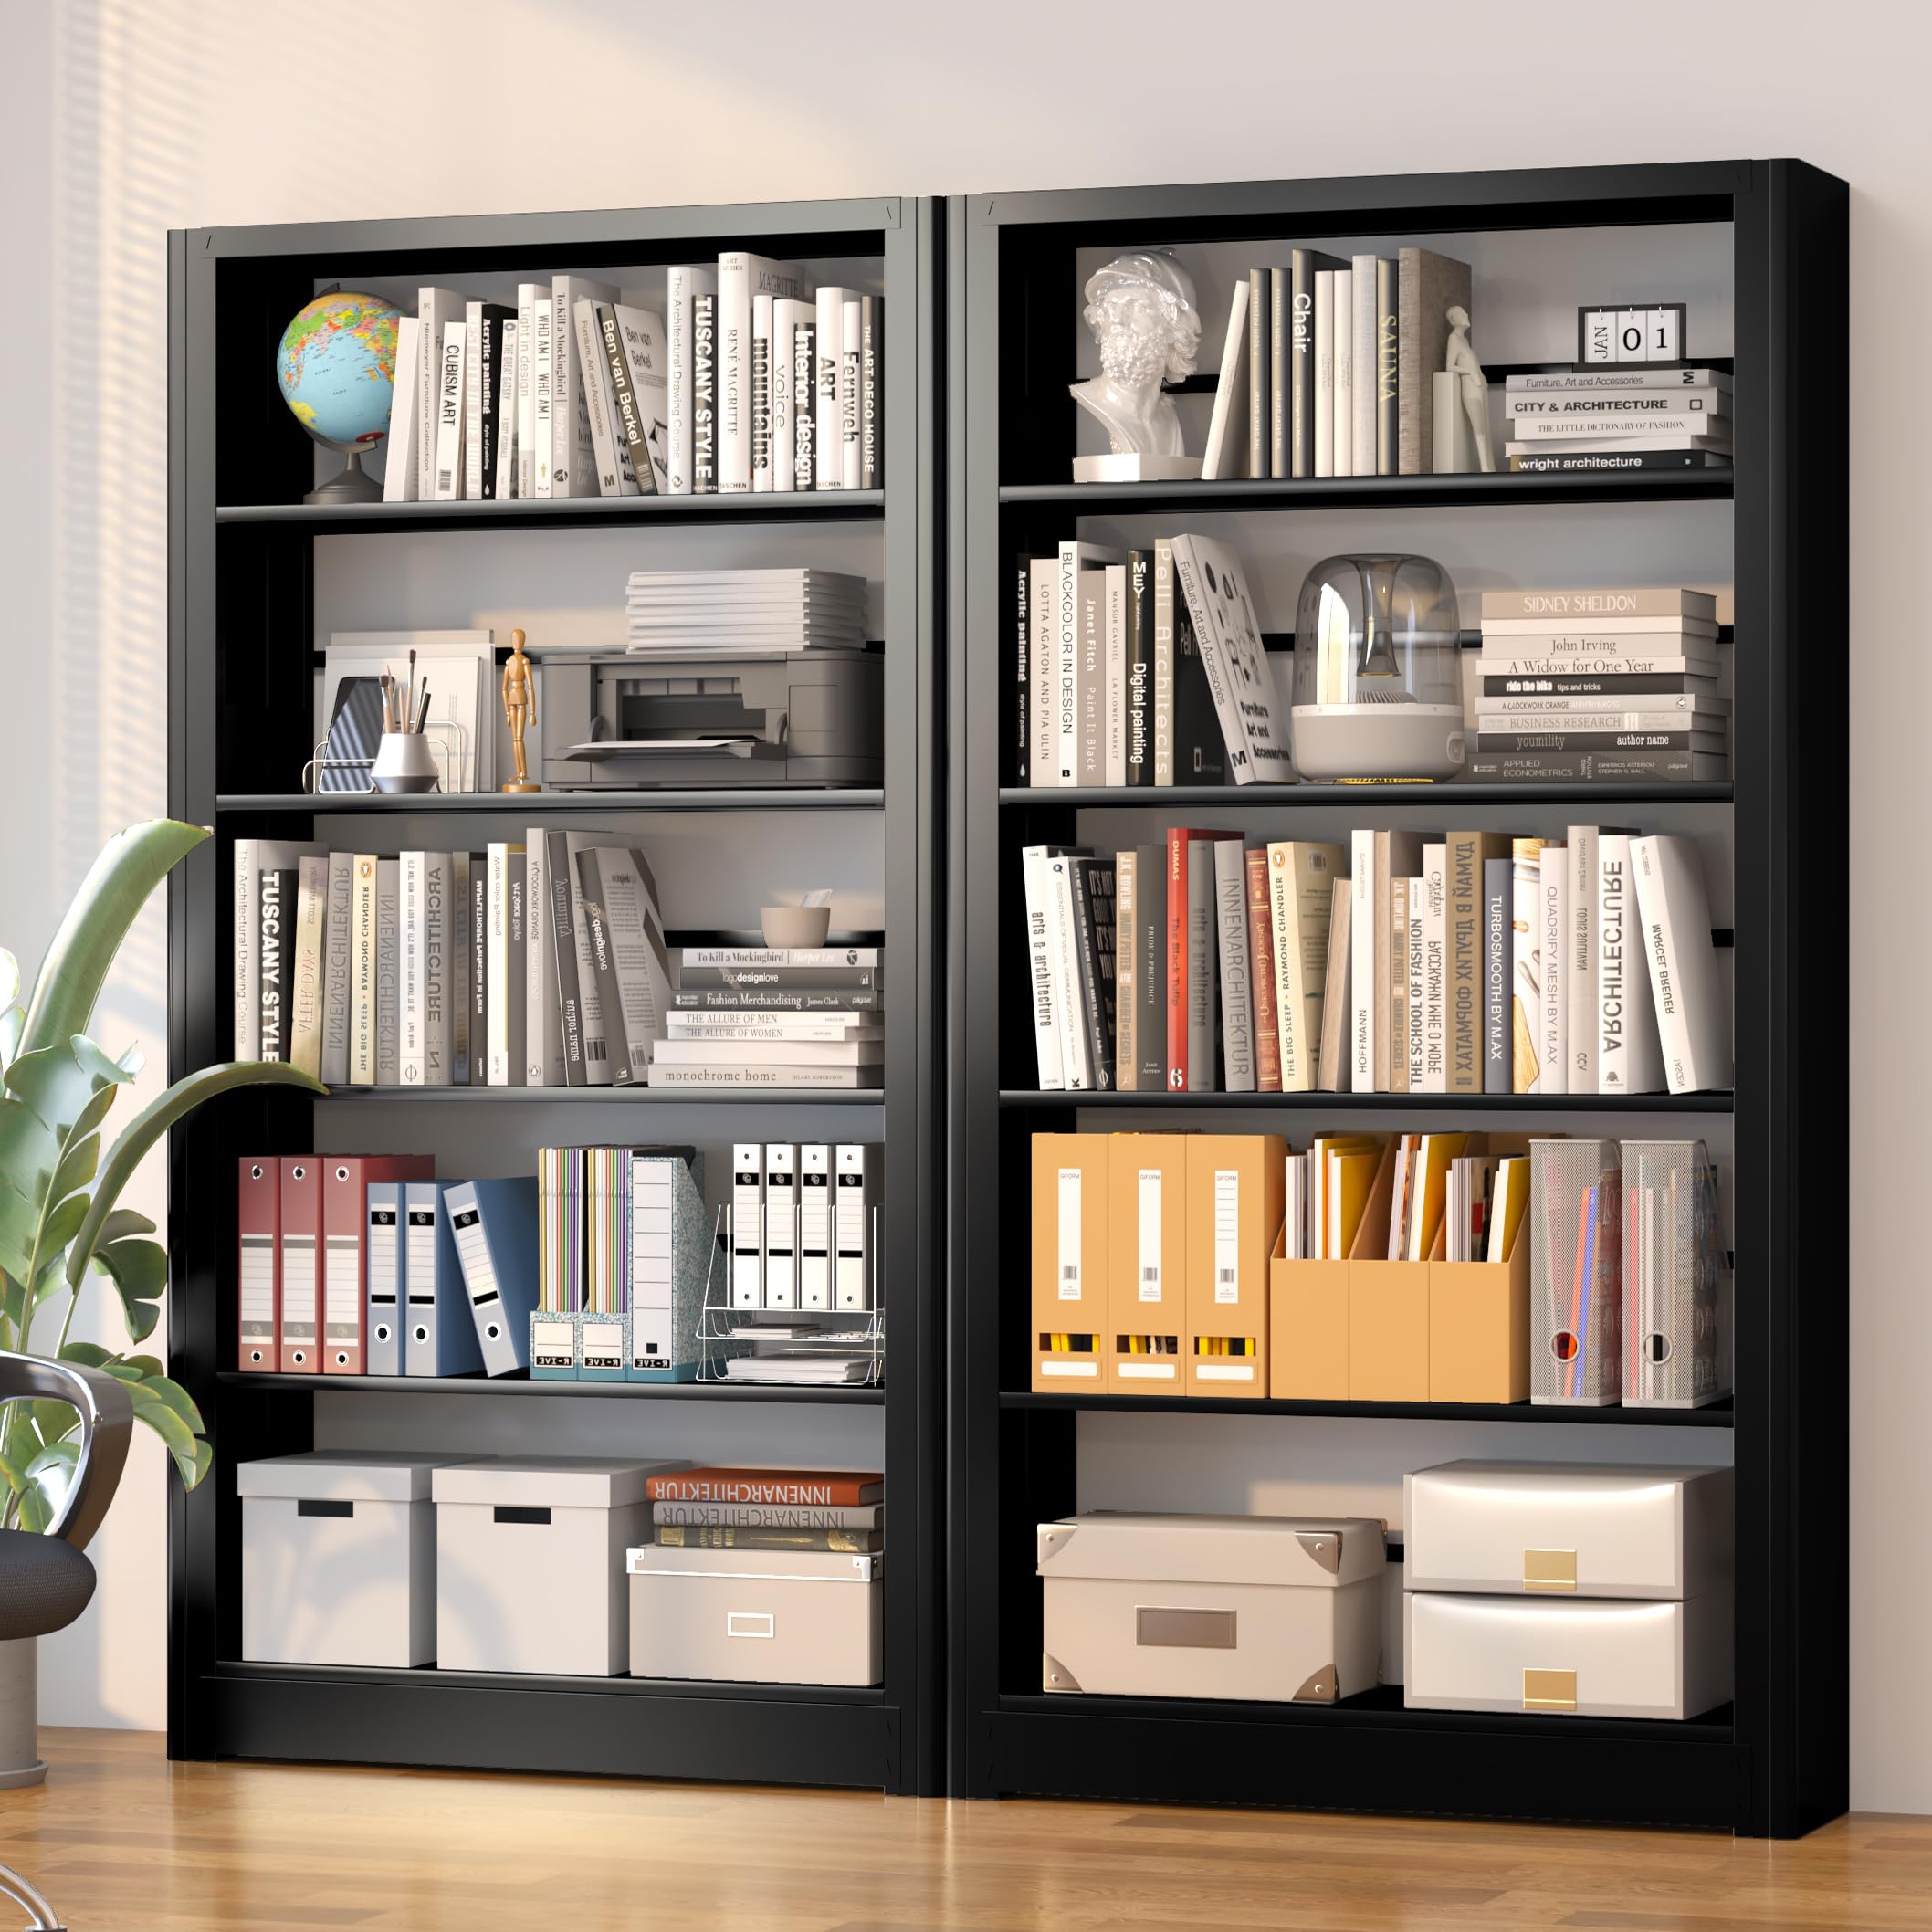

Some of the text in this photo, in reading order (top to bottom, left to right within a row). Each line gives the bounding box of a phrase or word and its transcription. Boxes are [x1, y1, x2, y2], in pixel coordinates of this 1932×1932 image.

[759, 271, 799, 298] MAGRITTE
[482, 319, 491, 360] Acrylic
[1293, 293, 1312, 353] Chair
[1594, 326, 1608, 359] JAN
[671, 276, 683, 459] The Architectural Drawing Course
[820, 357, 835, 401] ART
[864, 349, 875, 376] ART
[1380, 314, 1397, 403] SAUNA
[1682, 371, 1694, 384] M
[442, 345, 460, 426] CUBISM ART
[482, 362, 491, 415] painting
[602, 320, 642, 446] Ben van Berkel
[695, 297, 713, 478] TUSCANY STYLE
[727, 329, 740, 436] RENÉ MAGRITTE
[775, 365, 789, 428] voice
[843, 351, 860, 443] Fernweh
[864, 382, 875, 419] DECO
[1526, 376, 1643, 388] Furniture, Art and Accessories
[753, 337, 770, 470] mountains
[795, 330, 816, 486] Interior design
[1514, 399, 1668, 413] CITY & ARCHITECTURE
[1538, 420, 1685, 433] THE LITTLE DICTIONARY OF FASHION
[864, 425, 875, 473] HOUSE
[1518, 457, 1643, 471] wright architecture
[1132, 562, 1147, 600] MEY
[1523, 594, 1637, 613] SIDNEY SHELDON
[1062, 552, 1073, 734] BLACKCOLOR IN DESIGN
[1156, 548, 1171, 774] Pelli Architects
[1550, 638, 1617, 656] John Irving
[1041, 583, 1050, 760] LOTTA AGATON AND PIA ULIN
[1087, 598, 1097, 771] Janet Fitch Paint It Black
[1508, 657, 1654, 674] A Widow for One Year
[1129, 663, 1147, 764] Digital painting
[1509, 717, 1561, 729] BUSINESS
[1563, 716, 1622, 729] RESEARCH
[1231, 750, 1248, 768] M
[1516, 733, 1670, 751] youmility author name
[1503, 760, 1540, 768] APPLIED
[1503, 769, 1573, 777] ECONOMETRICS
[1172, 840, 1181, 881] DUMAS
[262, 871, 280, 1062] TUSCANY STYLE
[722, 972, 779, 984] logodesignlove
[1221, 877, 1250, 1076] INNENARCHITEKTUR
[1276, 877, 1297, 1077] THE BIG SLEEP RAYMOND CHANDLER
[1491, 895, 1503, 1060] TURBOSMOOTH BY M.AX
[1547, 887, 1558, 1065] QUADRIFY MESH BY M.AX
[686, 1013, 778, 1024] THE ALLURE OF MEN
[707, 992, 739, 1005] Fashion
[740, 992, 802, 1009] Merchandising
[805, 996, 823, 1007] James
[823, 996, 839, 1005] Clark
[1410, 919, 1423, 1086] THE SCHOOL OF FASHION
[685, 1028, 782, 1038] THE ALLURE OF WOMEN
[1359, 1009, 1367, 1074] HOFFMANN
[665, 1069, 740, 1081] monochrome
[745, 1068, 777, 1081] home
[655, 1481, 832, 1505] INNENARCHITEKTUR
[662, 1507, 845, 1528] INNENARCHITEKTUR
